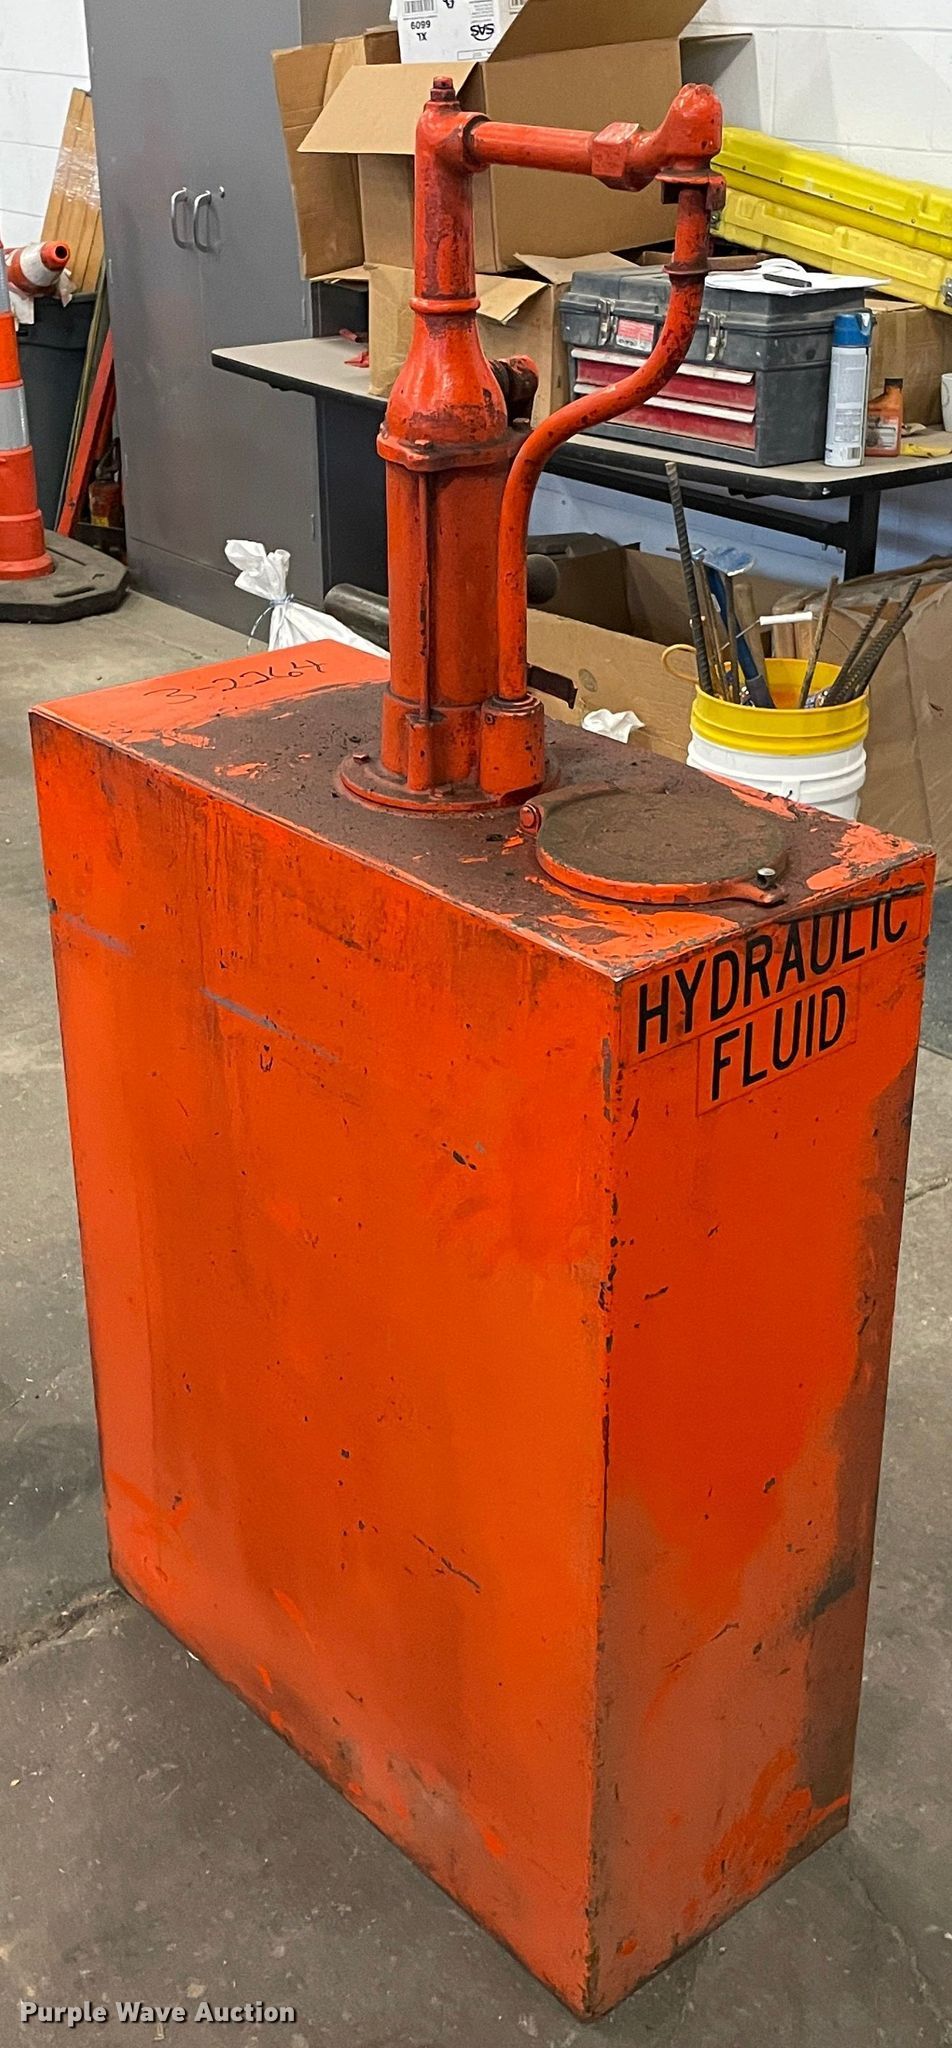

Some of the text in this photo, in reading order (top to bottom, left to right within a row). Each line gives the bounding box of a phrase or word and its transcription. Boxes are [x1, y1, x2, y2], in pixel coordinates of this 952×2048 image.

[410, 20, 431, 30] 6609
[470, 24, 495, 37] SAS
[416, 32, 428, 41] XL
[637, 898, 908, 1054] HYDRAULIC
[711, 985, 846, 1101] FLUID
